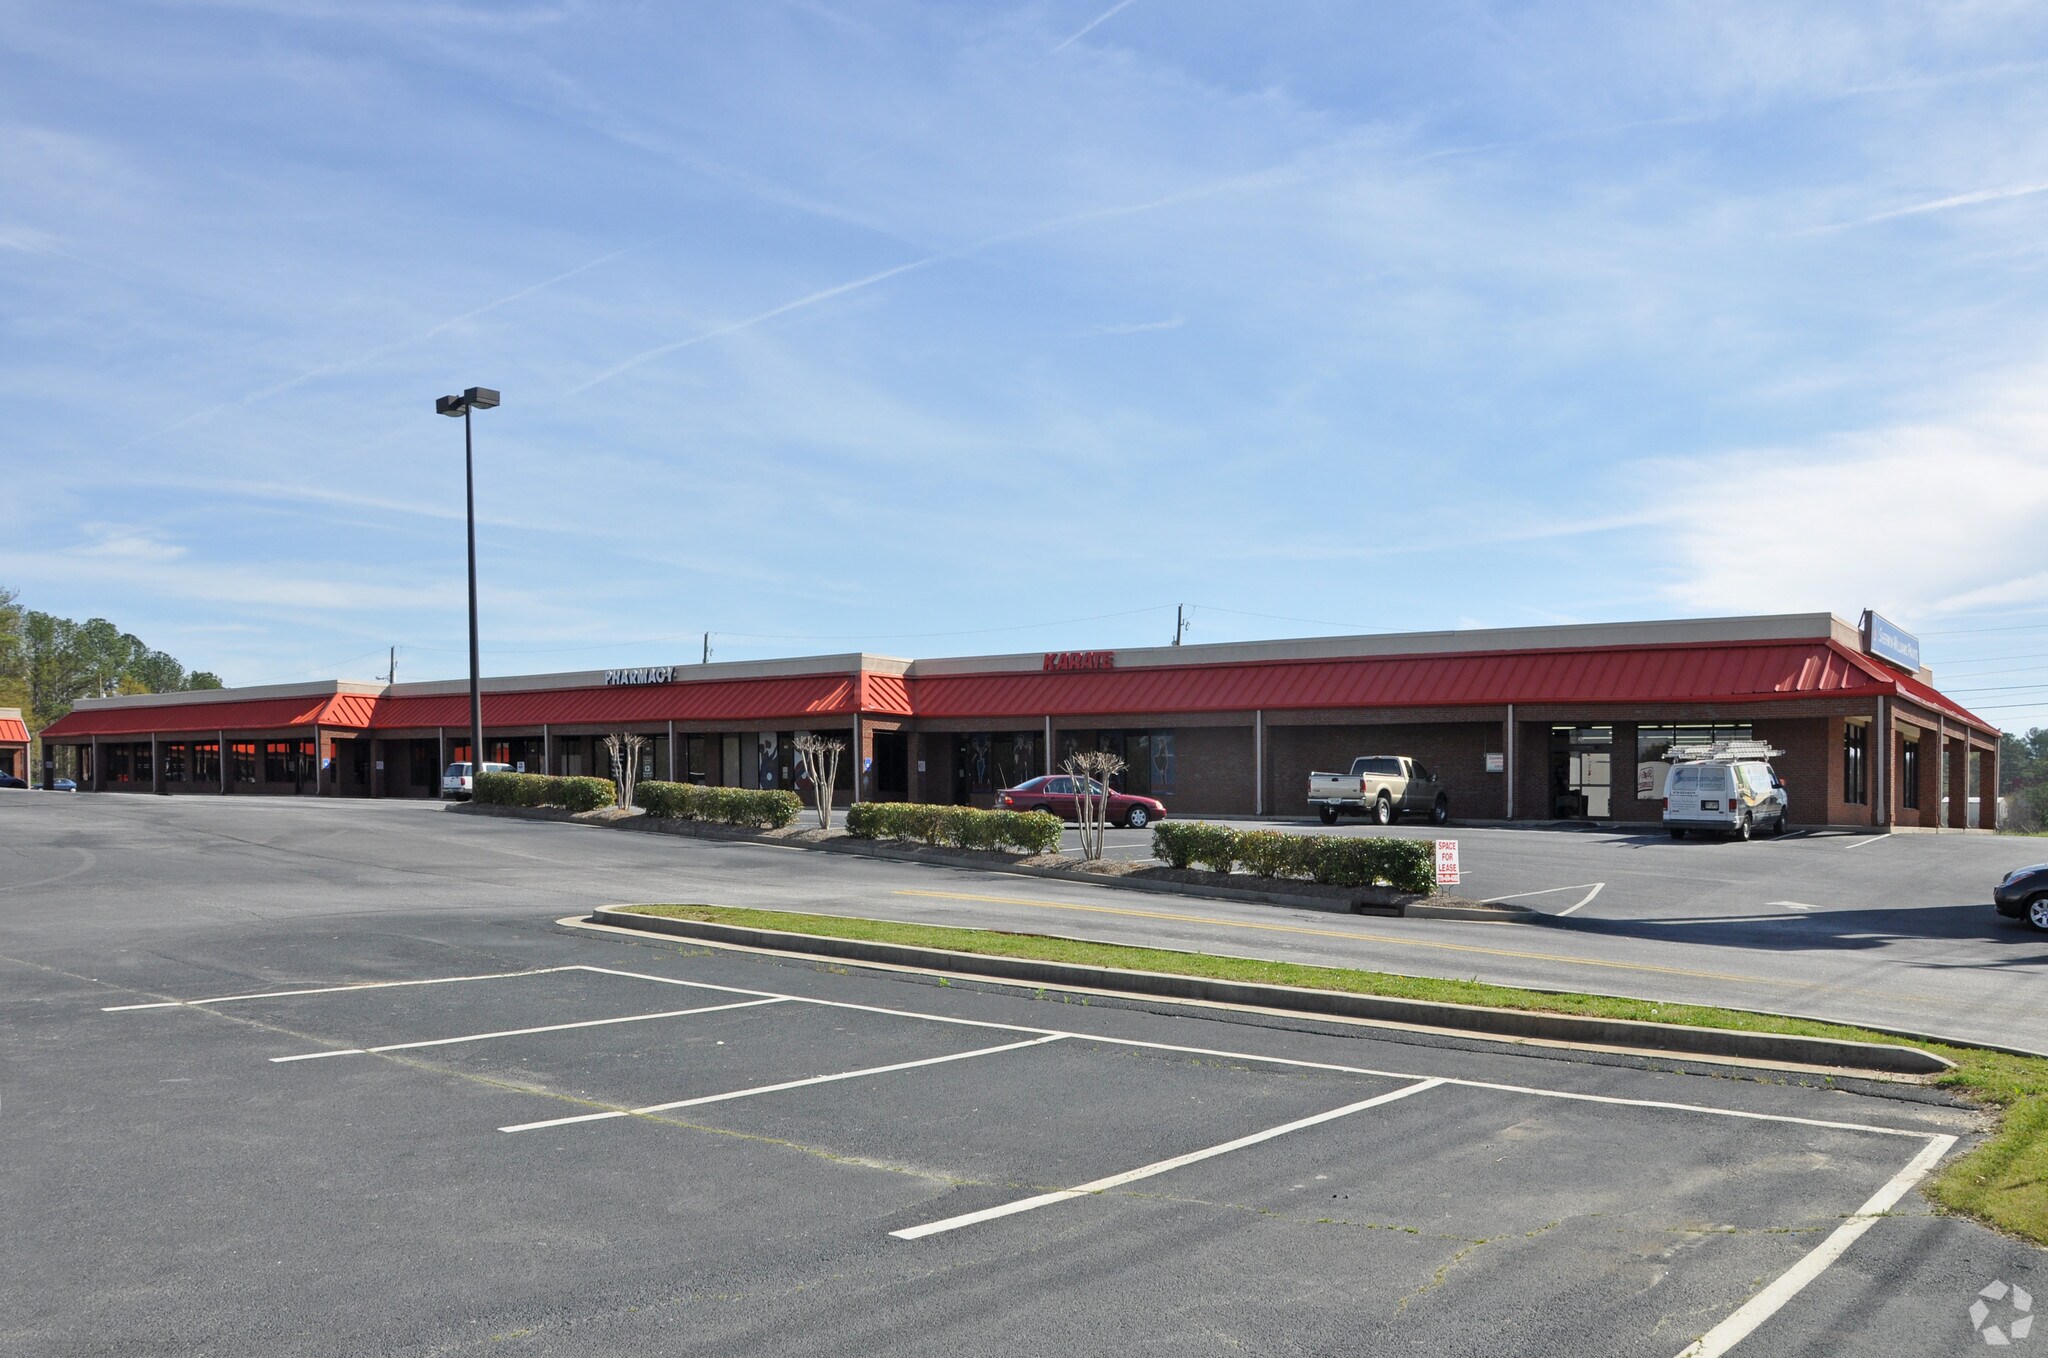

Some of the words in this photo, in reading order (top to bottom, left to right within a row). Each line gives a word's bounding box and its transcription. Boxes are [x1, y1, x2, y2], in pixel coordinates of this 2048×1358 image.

[1042, 651, 1116, 672] KARATE
[604, 667, 675, 685] PHARMACY
[1438, 841, 1456, 850] SPACE
[1441, 852, 1454, 861] FOR
[1438, 863, 1457, 872] LEASE
